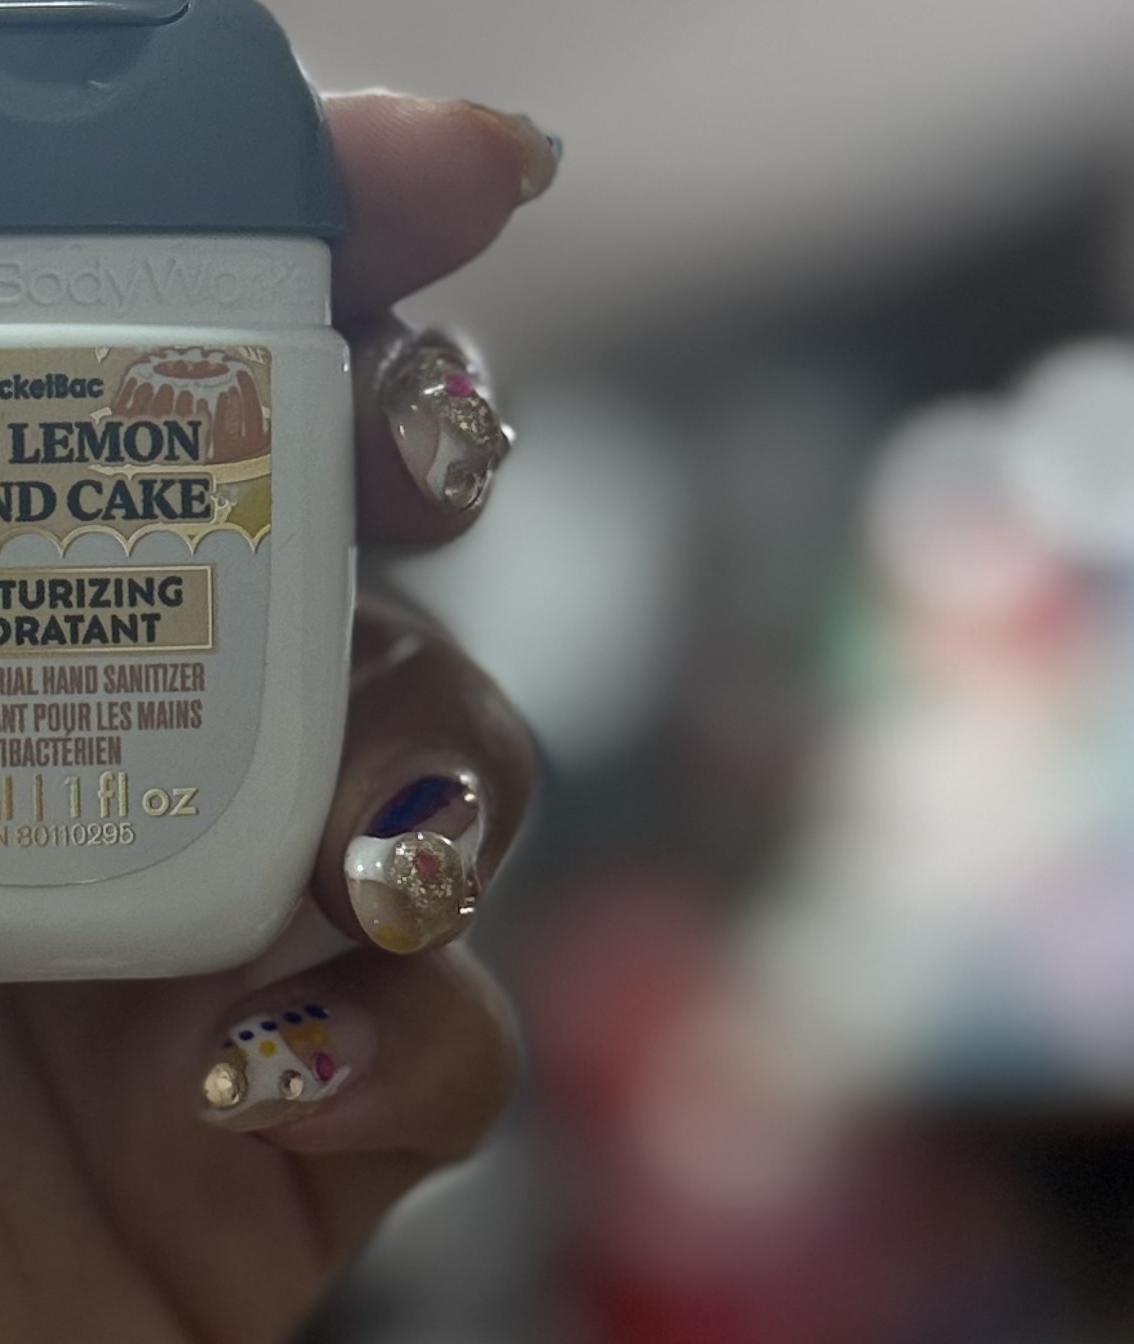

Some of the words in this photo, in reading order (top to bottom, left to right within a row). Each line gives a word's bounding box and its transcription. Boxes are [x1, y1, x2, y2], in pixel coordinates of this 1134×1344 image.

[8, 419, 202, 465] LEMON
[67, 477, 213, 523] CAKE
[42, 664, 99, 695] HAND
[103, 662, 207, 693] SANITIZER
[33, 703, 92, 733] POUR
[97, 701, 132, 731] LES
[137, 699, 203, 730] MAINS
[64, 776, 81, 818] 1
[98, 771, 129, 818] fl
[142, 787, 199, 817] oz
[17, 822, 136, 847] 80110295
